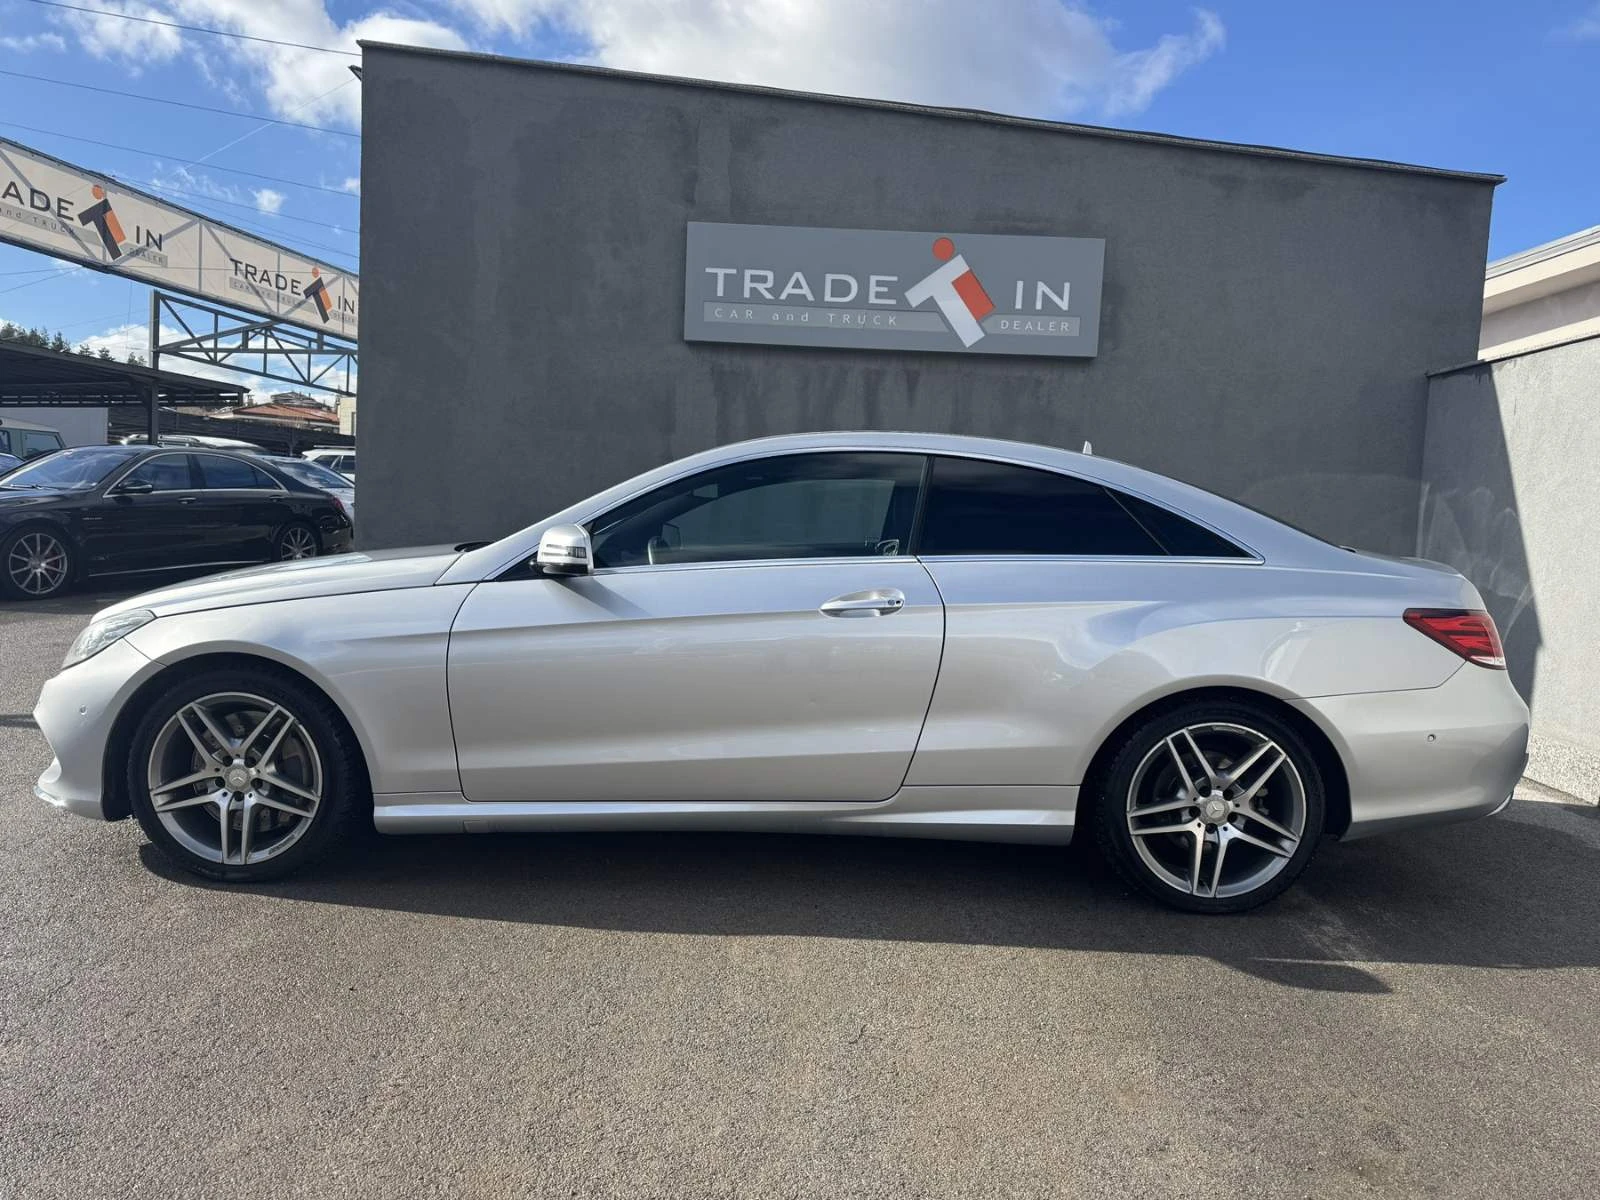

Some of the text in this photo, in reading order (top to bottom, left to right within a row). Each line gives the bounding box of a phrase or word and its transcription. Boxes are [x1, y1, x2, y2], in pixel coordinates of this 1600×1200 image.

[0, 207, 22, 219] nd
[136, 225, 163, 252] IN
[229, 258, 302, 296] TRADE
[337, 295, 355, 315] IN
[704, 267, 898, 305] TRADE
[1014, 280, 1071, 311] IN
[714, 307, 1071, 332] CAR and TRUCK DEALER
